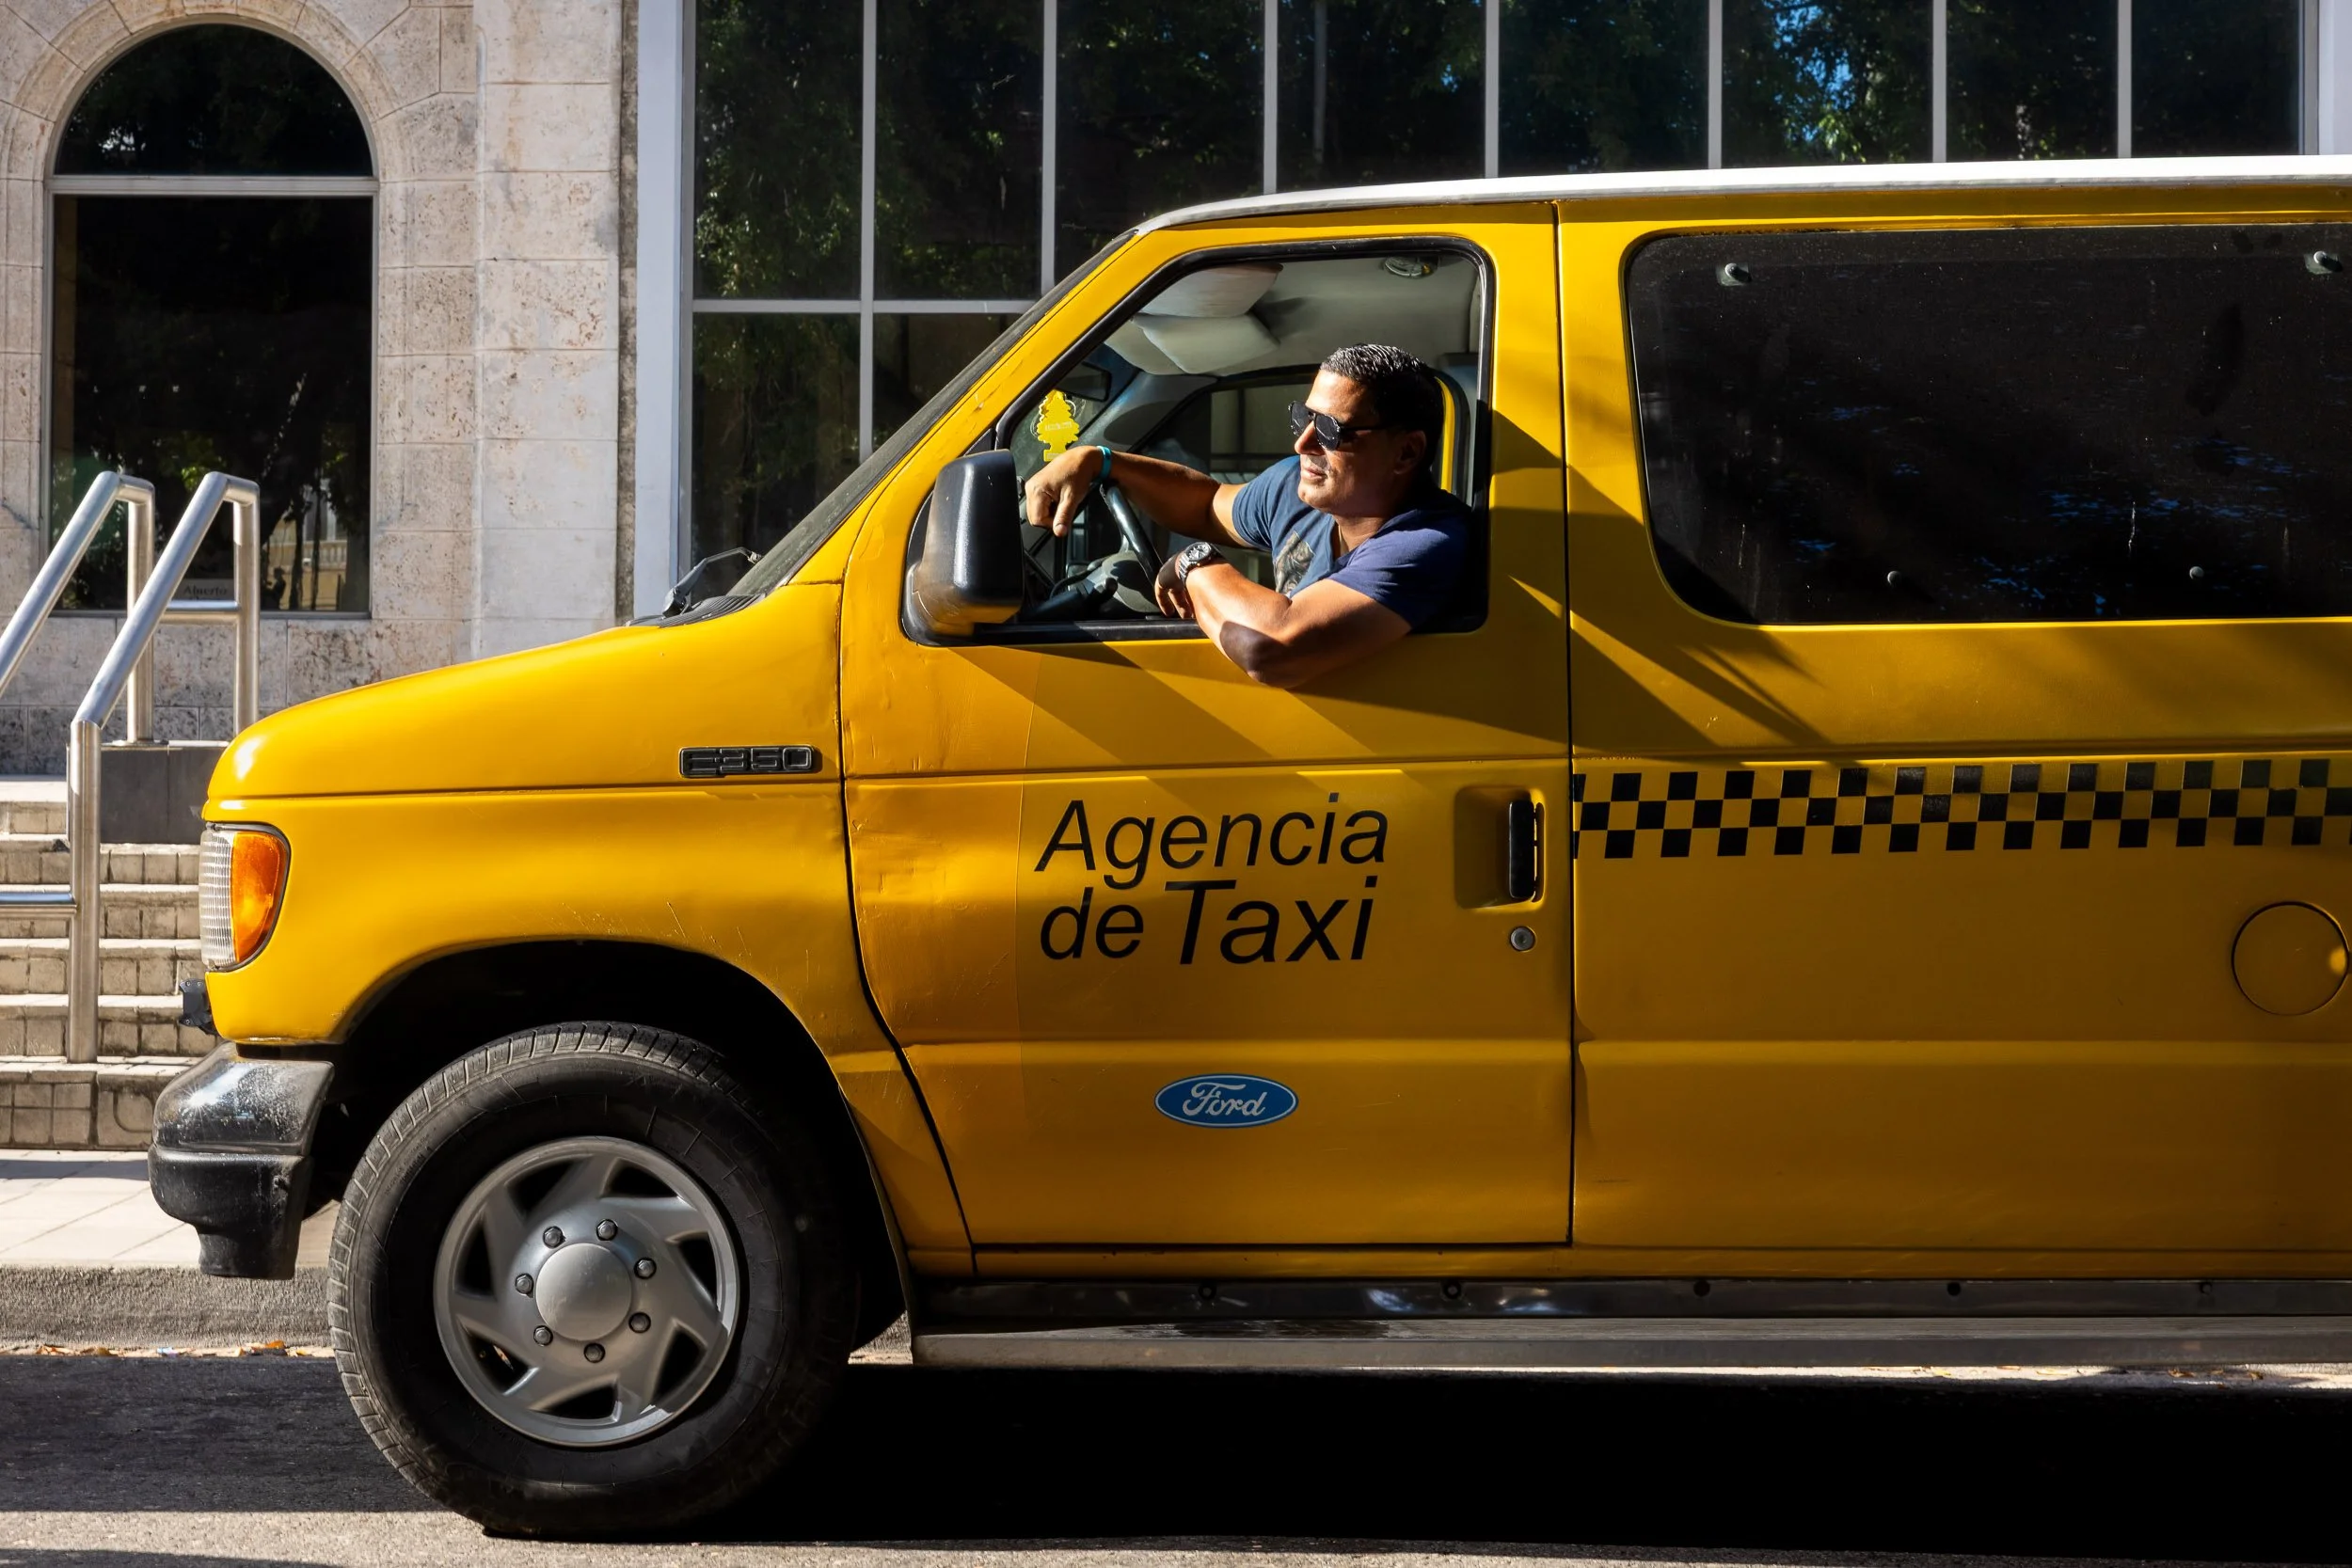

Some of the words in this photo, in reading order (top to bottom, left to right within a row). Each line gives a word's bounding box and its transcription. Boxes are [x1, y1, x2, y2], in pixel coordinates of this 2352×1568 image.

[1035, 792, 1388, 890] Agencia
[1041, 887, 1144, 959] de
[1165, 876, 1378, 965] Taxi
[1182, 1082, 1268, 1117] Ford
